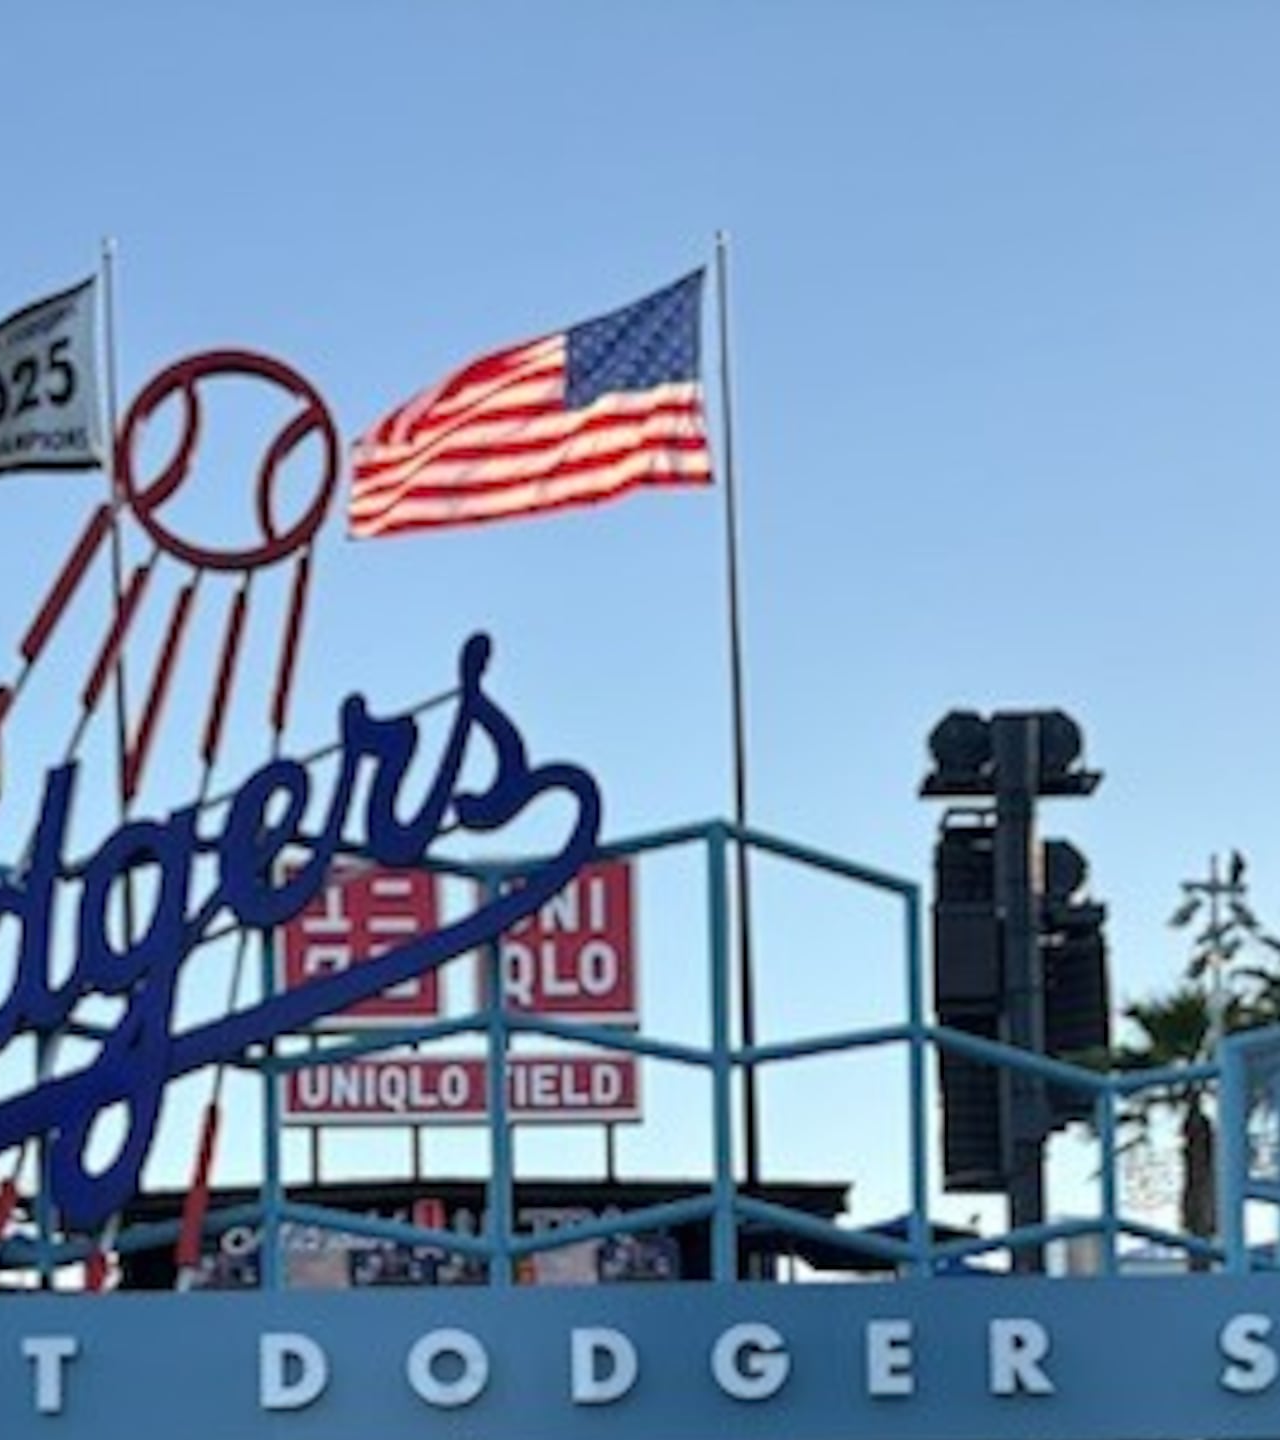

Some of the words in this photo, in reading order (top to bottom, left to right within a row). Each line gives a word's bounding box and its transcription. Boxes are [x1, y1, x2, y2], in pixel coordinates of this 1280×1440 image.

[499, 939, 619, 1006] QLO
[298, 1065, 470, 1112] UNIQLO
[504, 1064, 621, 1107] IELD
[258, 1318, 1055, 1409] DODGER
